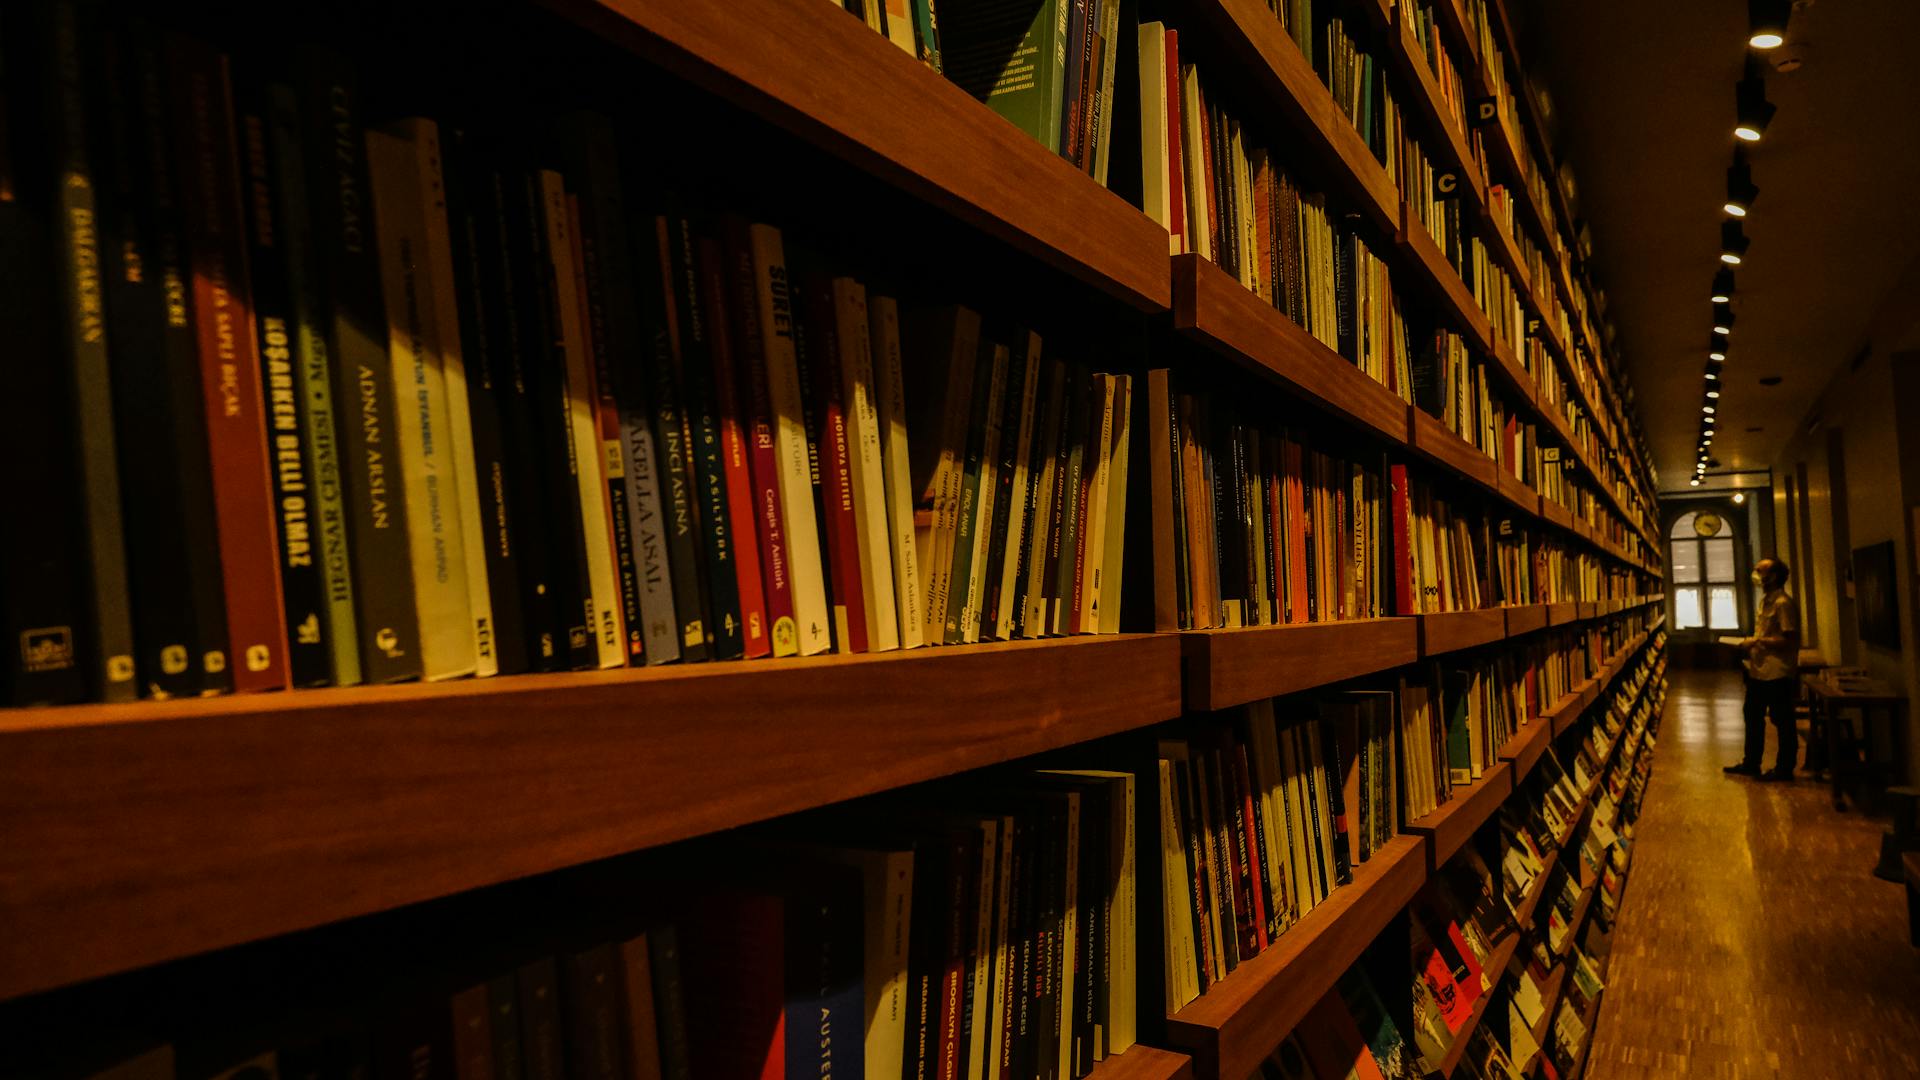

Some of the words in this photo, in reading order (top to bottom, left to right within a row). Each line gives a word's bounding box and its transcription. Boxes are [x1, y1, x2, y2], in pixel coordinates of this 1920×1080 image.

[1479, 102, 1495, 120] D
[1437, 173, 1457, 193] C
[769, 264, 792, 341] SURET
[1529, 319, 1540, 333] F
[263, 316, 297, 431] KOŞARKEN
[357, 364, 382, 443] ADNAN
[276, 433, 306, 492] BELLİ
[366, 447, 390, 529] ARSLAN
[835, 415, 847, 465] MOSKOVA
[841, 469, 851, 512] DEFTERİ
[1564, 458, 1575, 470] H
[671, 477, 689, 536] ASENA
[962, 488, 973, 511] EROL
[1499, 520, 1513, 535] E
[281, 496, 312, 568] OLMAZ
[641, 529, 661, 593] ASAL
[1022, 939, 1031, 992] KEHANET
[1046, 930, 1054, 995] LEVIATHAN
[921, 974, 929, 1024] BABAMIN
[949, 969, 959, 1038] BROOKLYN
[1002, 1030, 1011, 1068] ADAM
